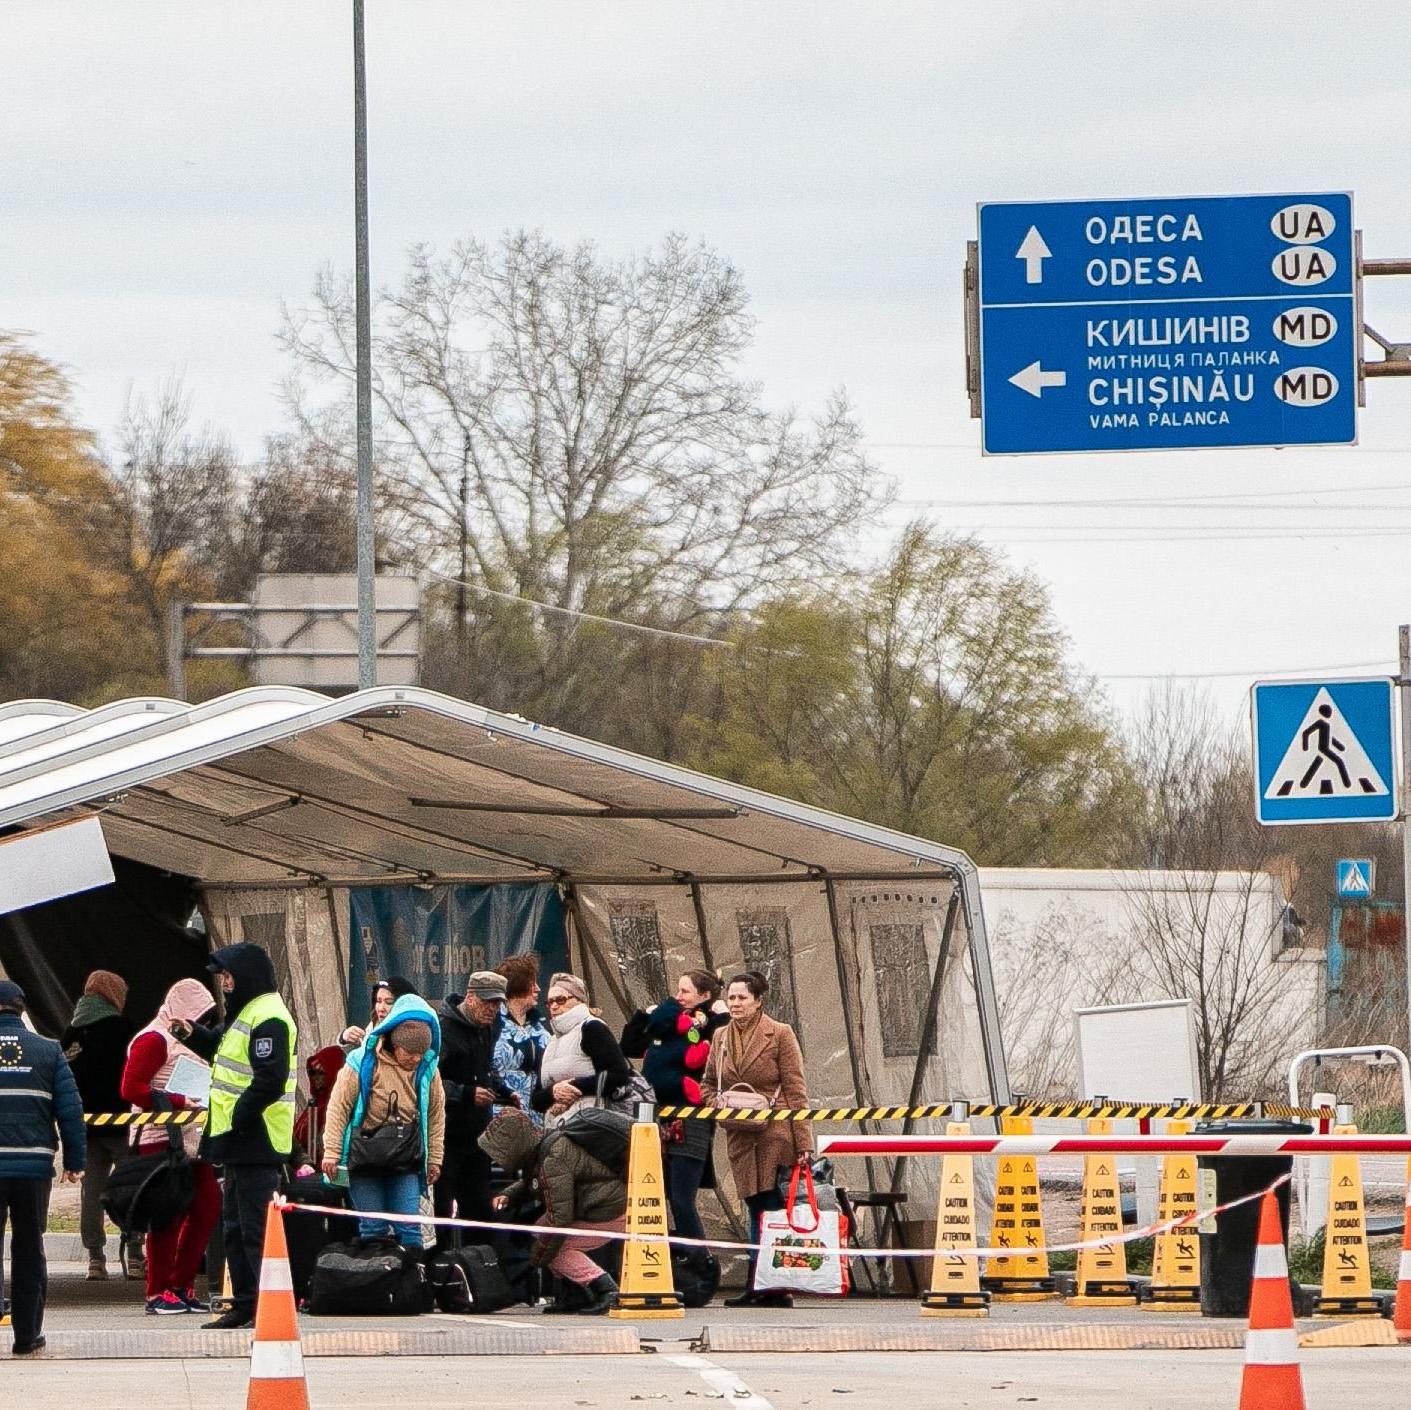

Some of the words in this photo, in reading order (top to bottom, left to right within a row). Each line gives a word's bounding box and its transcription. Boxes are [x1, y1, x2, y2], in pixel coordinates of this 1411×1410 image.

[1085, 214, 1204, 244] ОДЕСА
[1278, 211, 1326, 239] UA
[1086, 256, 1204, 286] ODESA
[1279, 254, 1327, 281] UA
[1087, 315, 1250, 348] КИШИНІВ
[1280, 313, 1332, 341] MD
[1088, 354, 1185, 371] МИТНИЦЯ
[1191, 350, 1280, 368] ПАЛАНКА
[1281, 373, 1333, 401] MD
[1090, 412, 1139, 430] VAMA
[1149, 410, 1230, 428] PALANCA
[943, 1215, 970, 1225] CUIDADO
